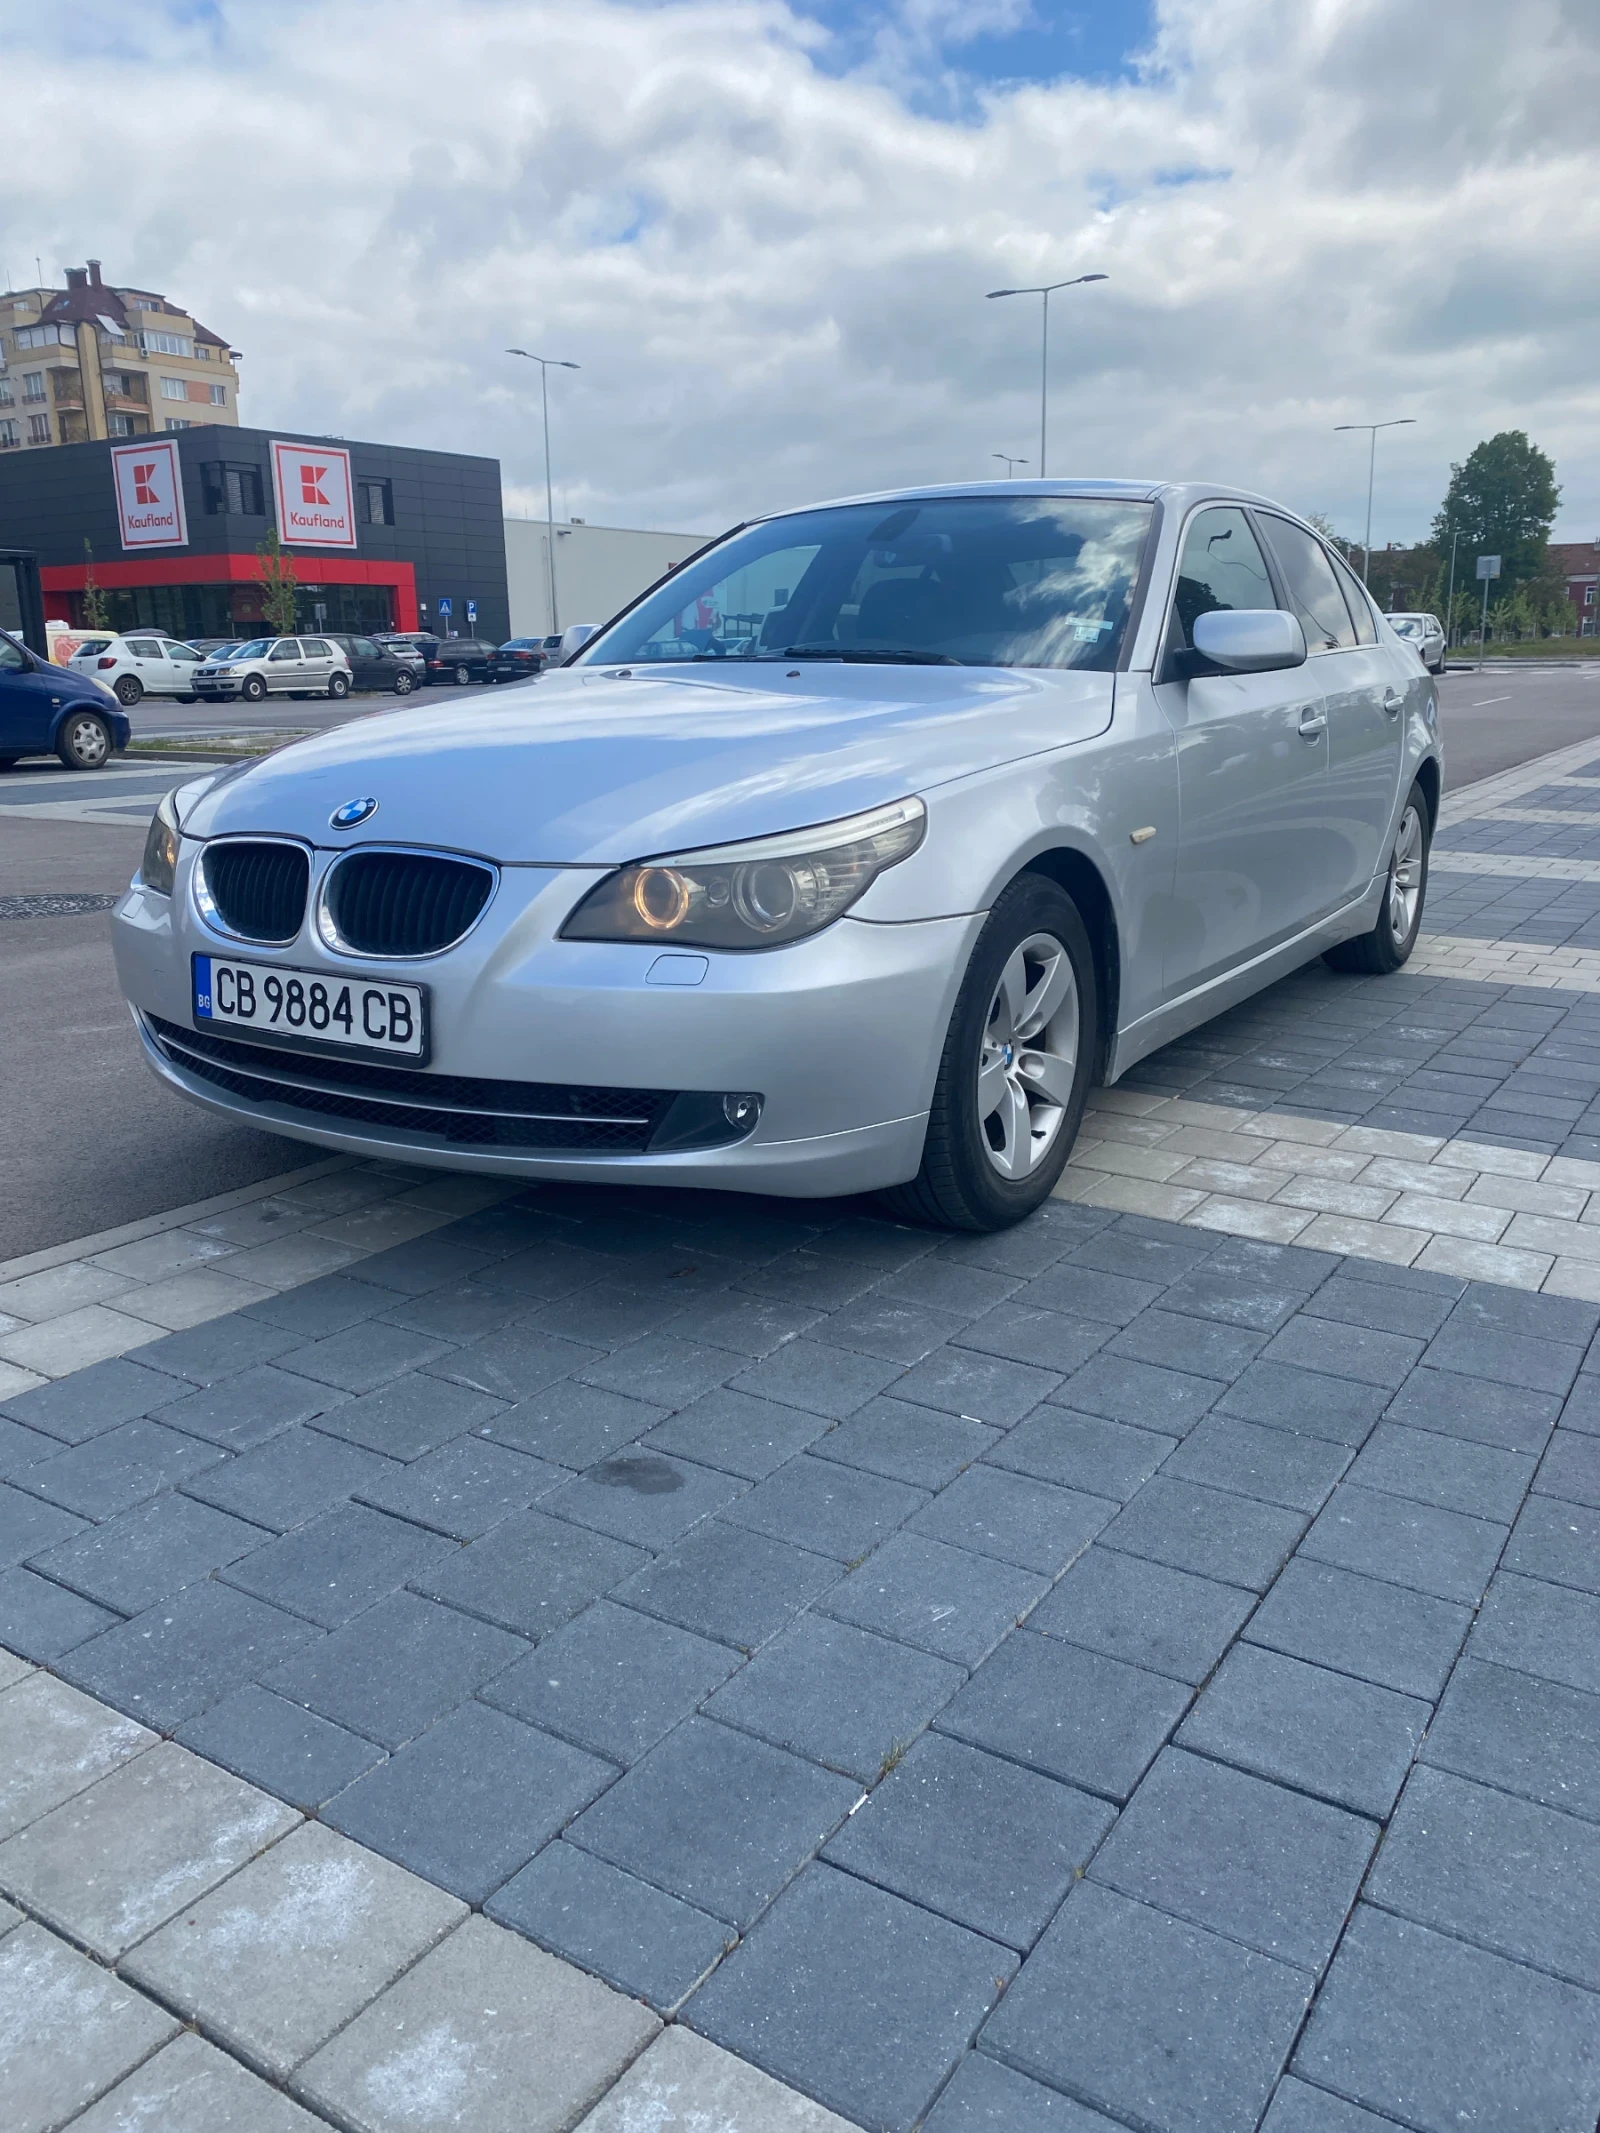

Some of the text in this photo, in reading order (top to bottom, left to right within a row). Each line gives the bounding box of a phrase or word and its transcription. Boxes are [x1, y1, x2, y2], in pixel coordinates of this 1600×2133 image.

[133, 464, 160, 504] K
[300, 465, 330, 505] K
[128, 512, 173, 529] Kaufland
[291, 512, 344, 528] Kaufland
[468, 602, 475, 612] P
[198, 994, 211, 1009] BG
[216, 967, 413, 1043] CB 9884 CB
